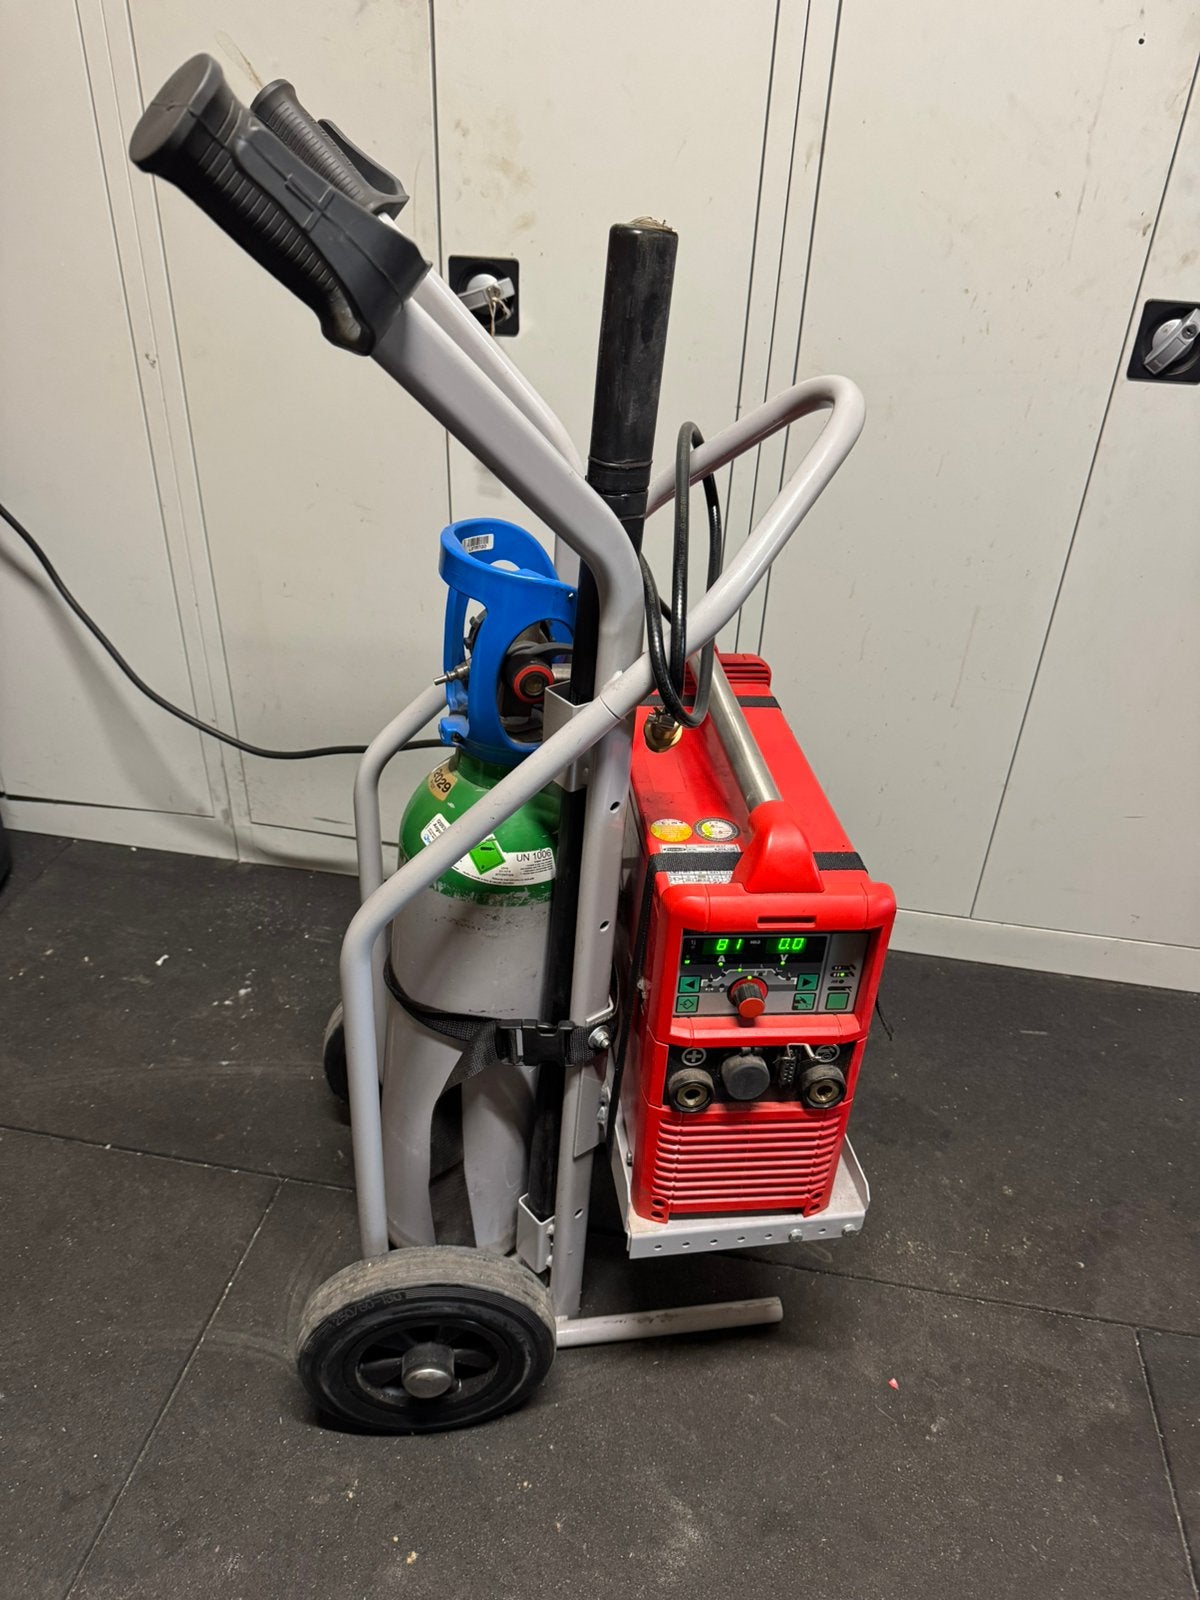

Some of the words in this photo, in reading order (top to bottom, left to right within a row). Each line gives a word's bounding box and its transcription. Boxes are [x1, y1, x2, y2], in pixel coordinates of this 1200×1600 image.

[434, 769, 452, 793] 2029
[516, 853, 530, 862] UN
[533, 849, 552, 860] 1006
[716, 938, 743, 951] 81
[778, 937, 805, 950] 0.0
[717, 955, 726, 963] A
